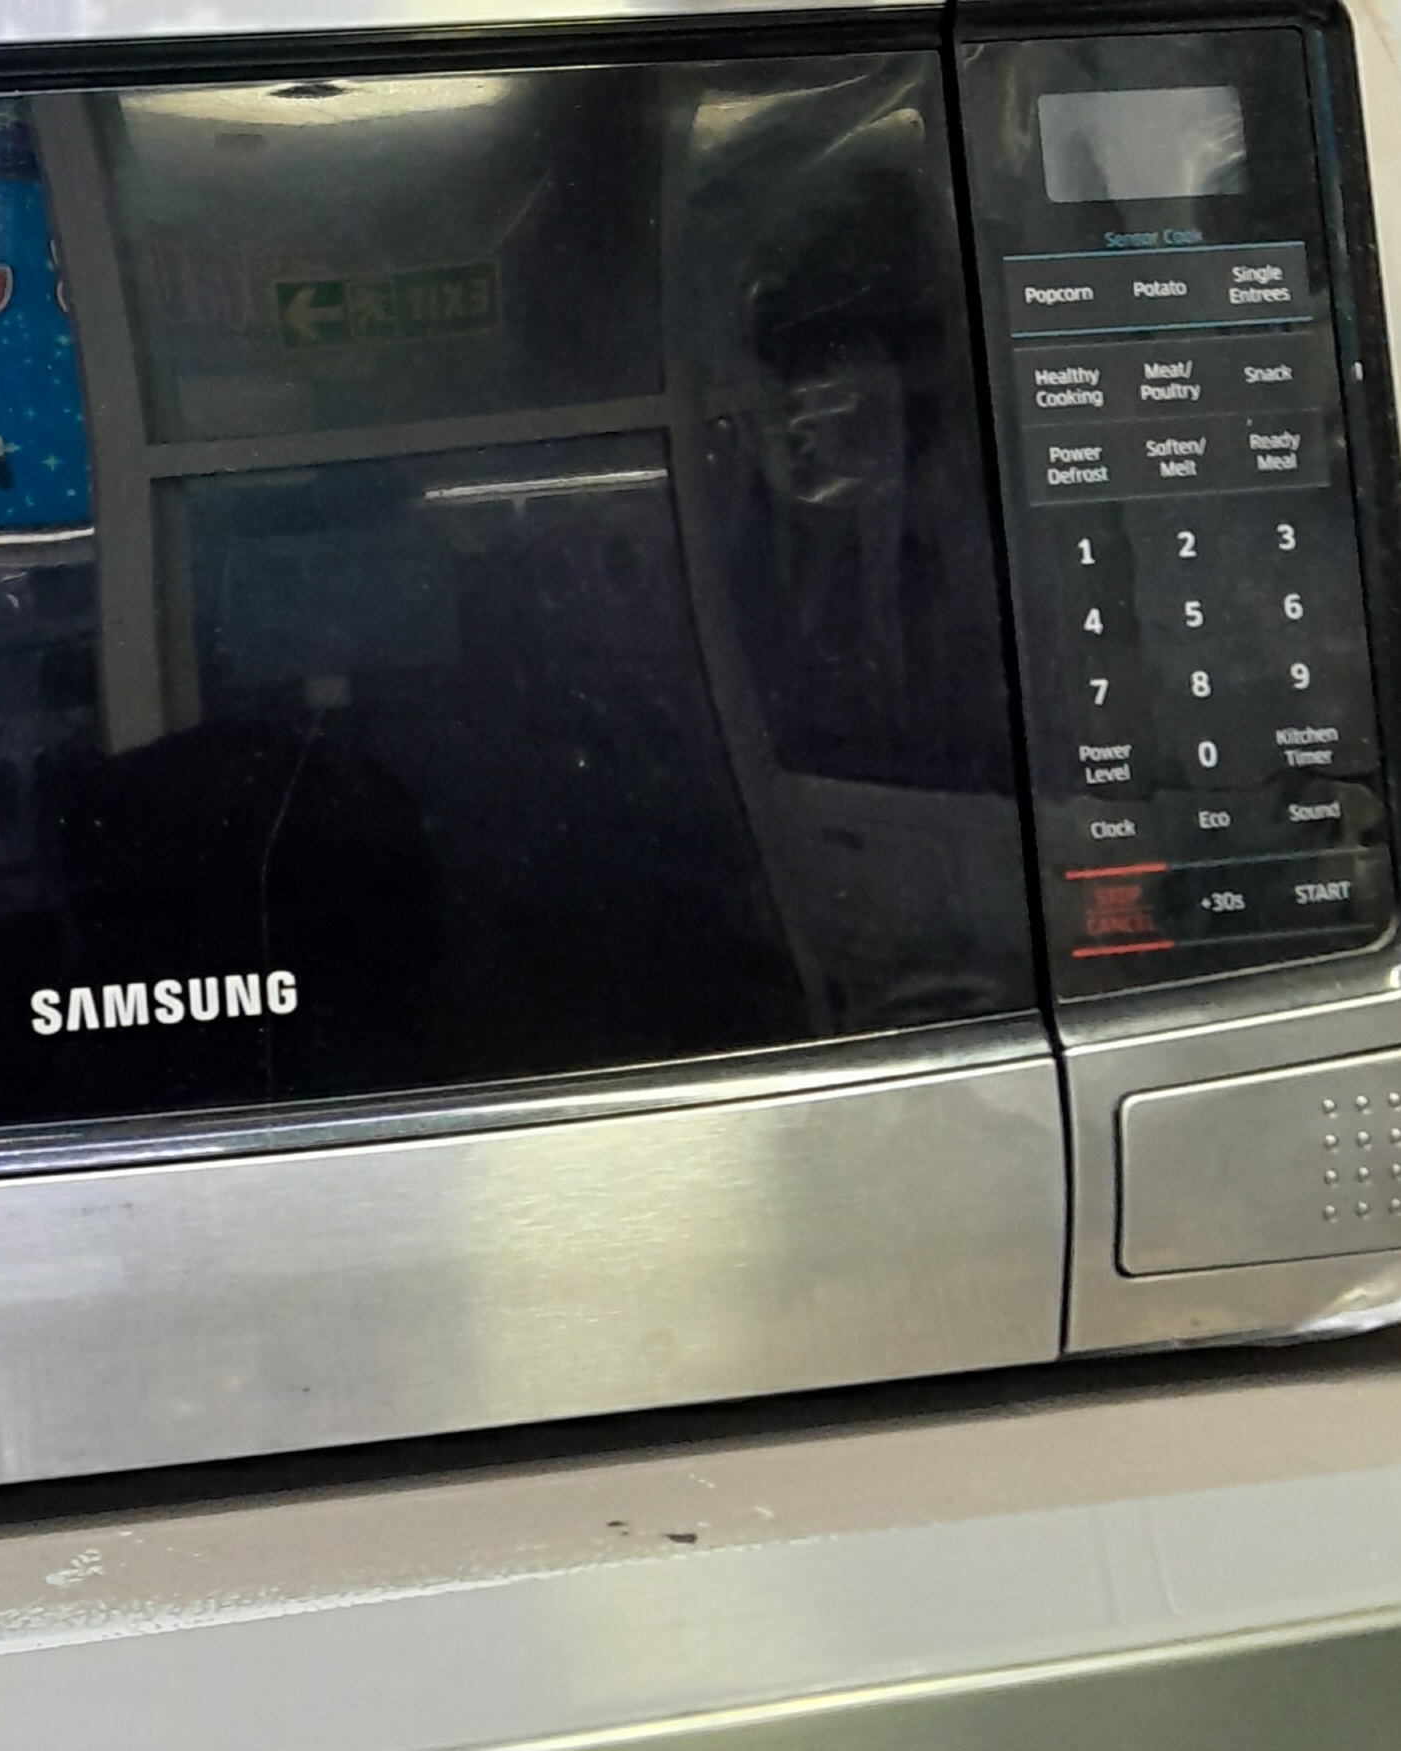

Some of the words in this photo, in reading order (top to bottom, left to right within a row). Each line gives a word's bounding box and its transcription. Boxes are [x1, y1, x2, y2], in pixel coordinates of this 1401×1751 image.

[1232, 265, 1283, 284] Single
[1025, 286, 1094, 305] Popcorn
[1133, 280, 1187, 297] Potato
[1229, 286, 1291, 304] Entrees
[1035, 367, 1100, 385] Healthy
[1144, 361, 1192, 379] Meat/
[1244, 365, 1292, 382] Snack
[1036, 387, 1103, 408] Cooking
[1140, 384, 1200, 401] Poultry
[1146, 437, 1206, 457] Soften/
[1249, 431, 1300, 450] Ready
[1049, 446, 1102, 463] Power
[1257, 453, 1297, 471] Meal
[1047, 466, 1108, 485] Defrost
[1160, 461, 1198, 478] Melt
[1177, 531, 1197, 558] 2
[1277, 524, 1296, 550] 3
[1078, 538, 1095, 565] 1
[1185, 601, 1203, 628] 5
[1284, 594, 1303, 620] 6
[1084, 608, 1103, 634] 4
[1191, 670, 1211, 698] 8
[1290, 663, 1310, 690] 9
[1089, 678, 1109, 705] 7
[1276, 726, 1338, 745] Kitchen
[1079, 744, 1131, 761] Power
[1198, 741, 1218, 768] 0
[1285, 747, 1333, 767] Timer
[1086, 764, 1130, 784] Level
[1199, 810, 1231, 829] Eco
[1289, 801, 1341, 822] Sound
[1091, 819, 1135, 839] Clock
[1295, 882, 1351, 904] START
[30, 970, 298, 1036] SAMSUNG
